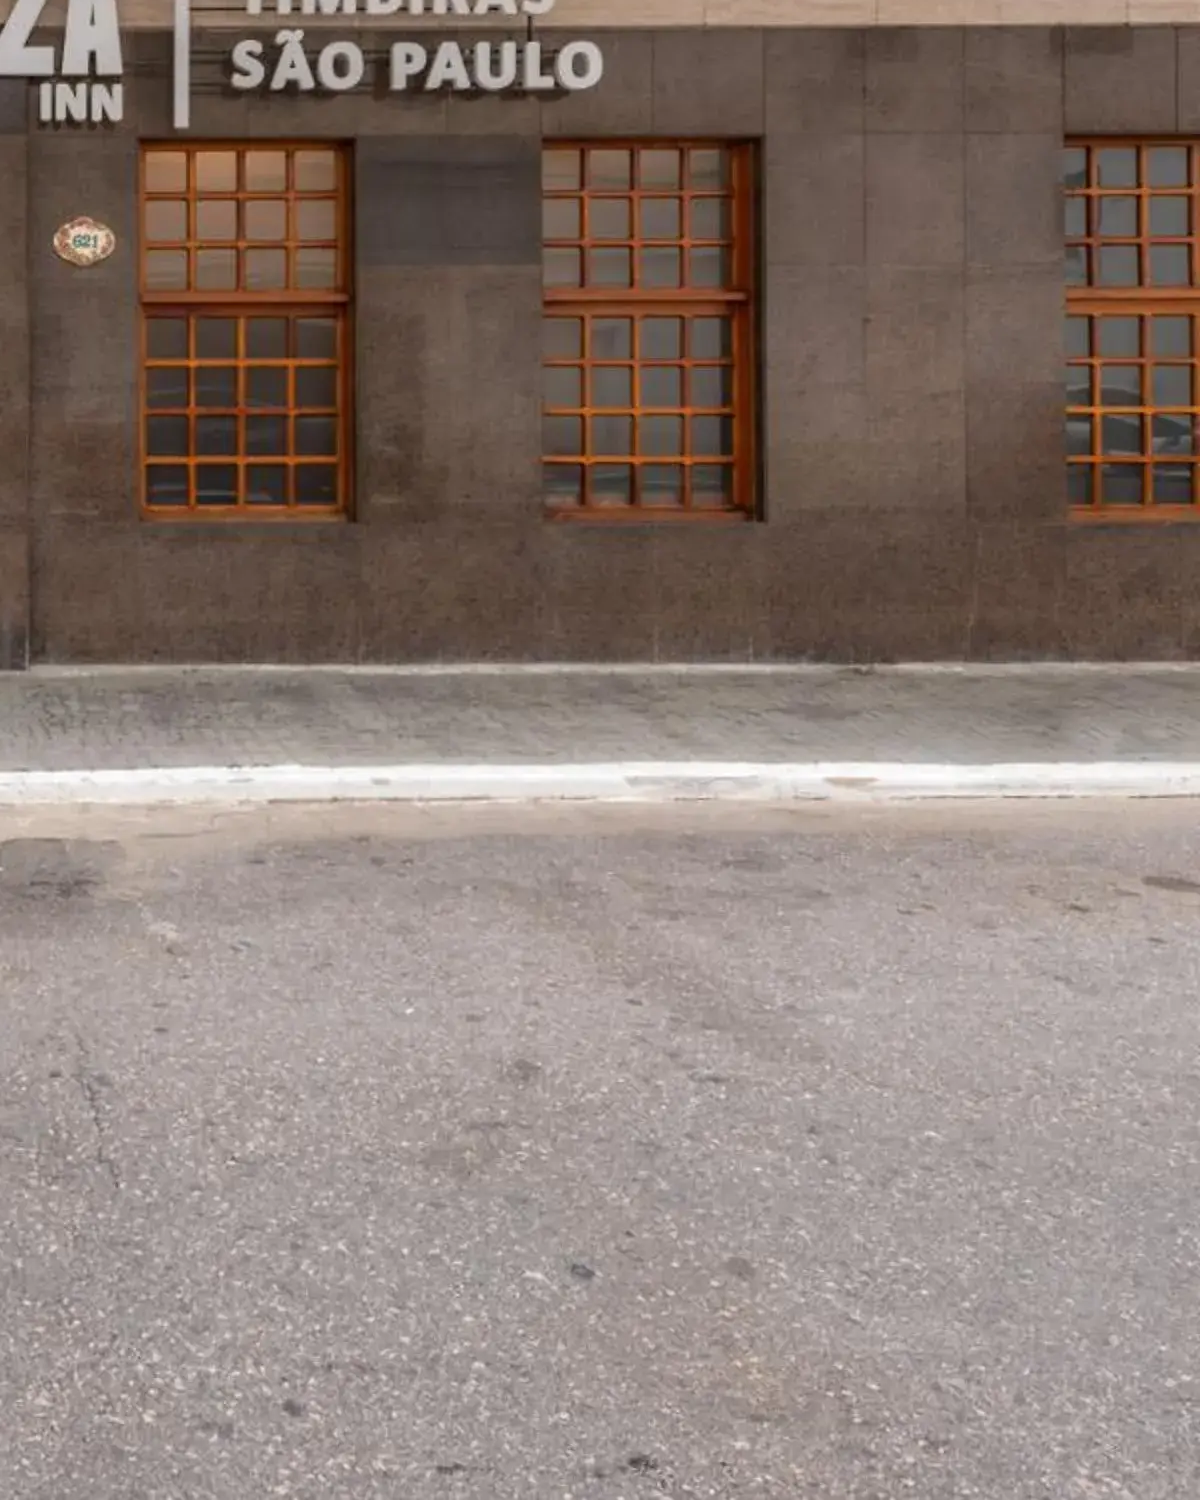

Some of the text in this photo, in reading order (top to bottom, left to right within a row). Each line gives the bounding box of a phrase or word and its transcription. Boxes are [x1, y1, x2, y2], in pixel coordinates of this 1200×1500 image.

[231, 29, 604, 91] SÃO PAULO
[39, 83, 123, 122] INN
